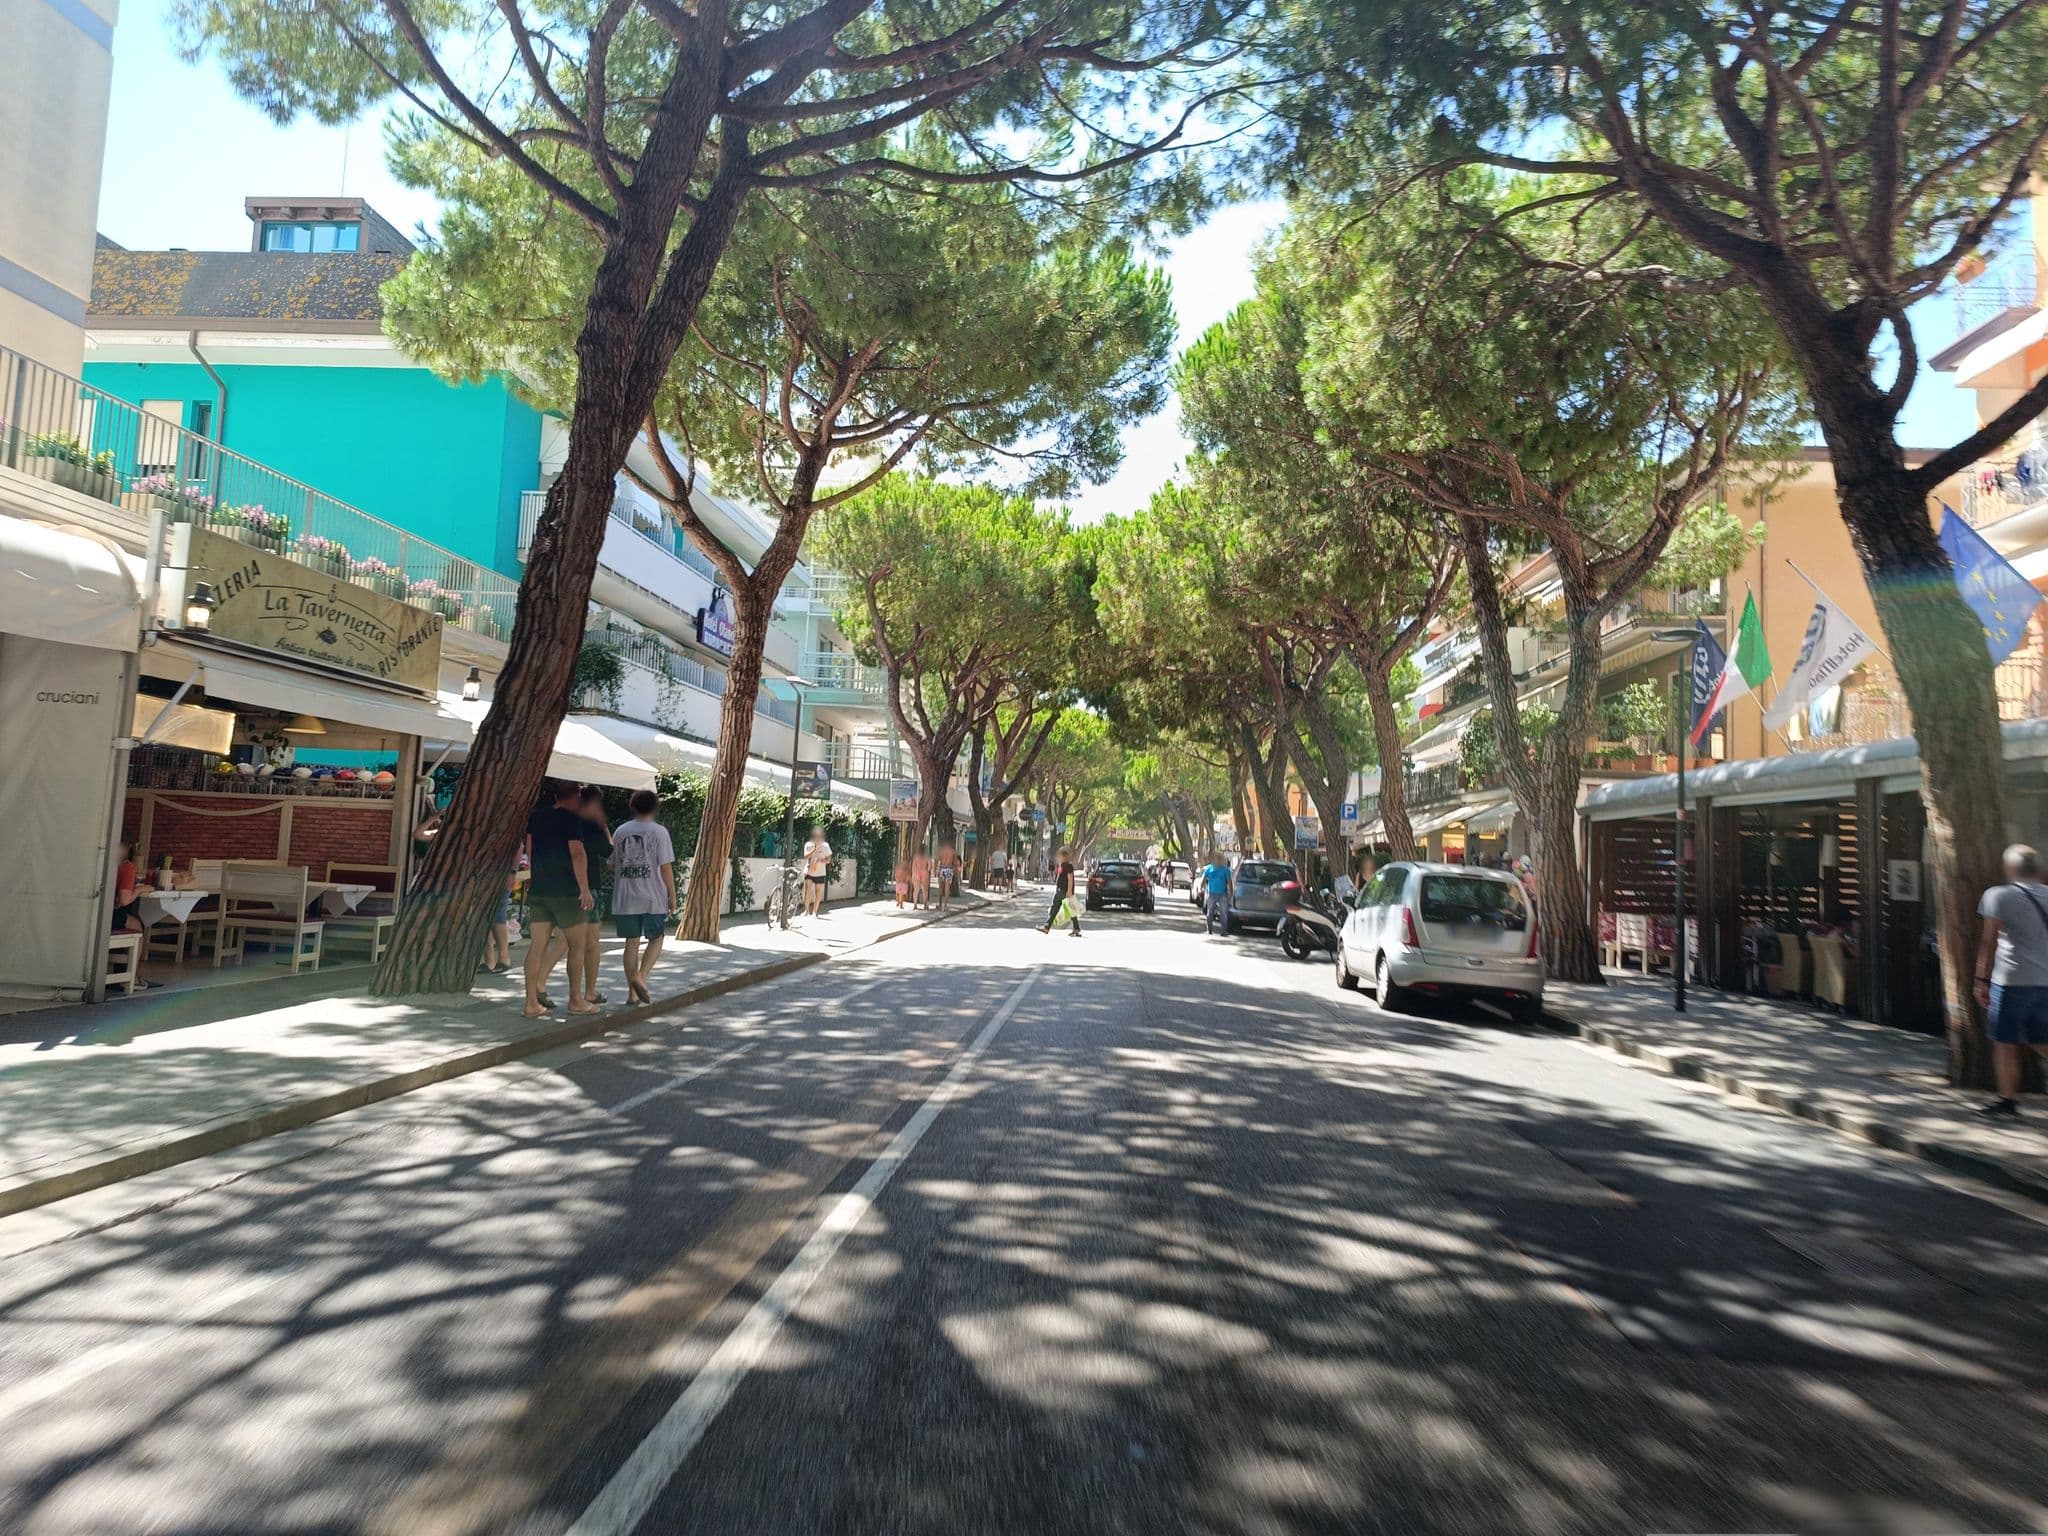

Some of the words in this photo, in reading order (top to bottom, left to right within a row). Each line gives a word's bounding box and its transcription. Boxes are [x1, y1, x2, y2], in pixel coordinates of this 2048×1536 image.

[265, 590, 288, 611] La
[296, 594, 385, 643] Tavernetta
[378, 616, 440, 678] RISTORANTE
[36, 691, 100, 705] cruciani
[1345, 805, 1355, 818] P
